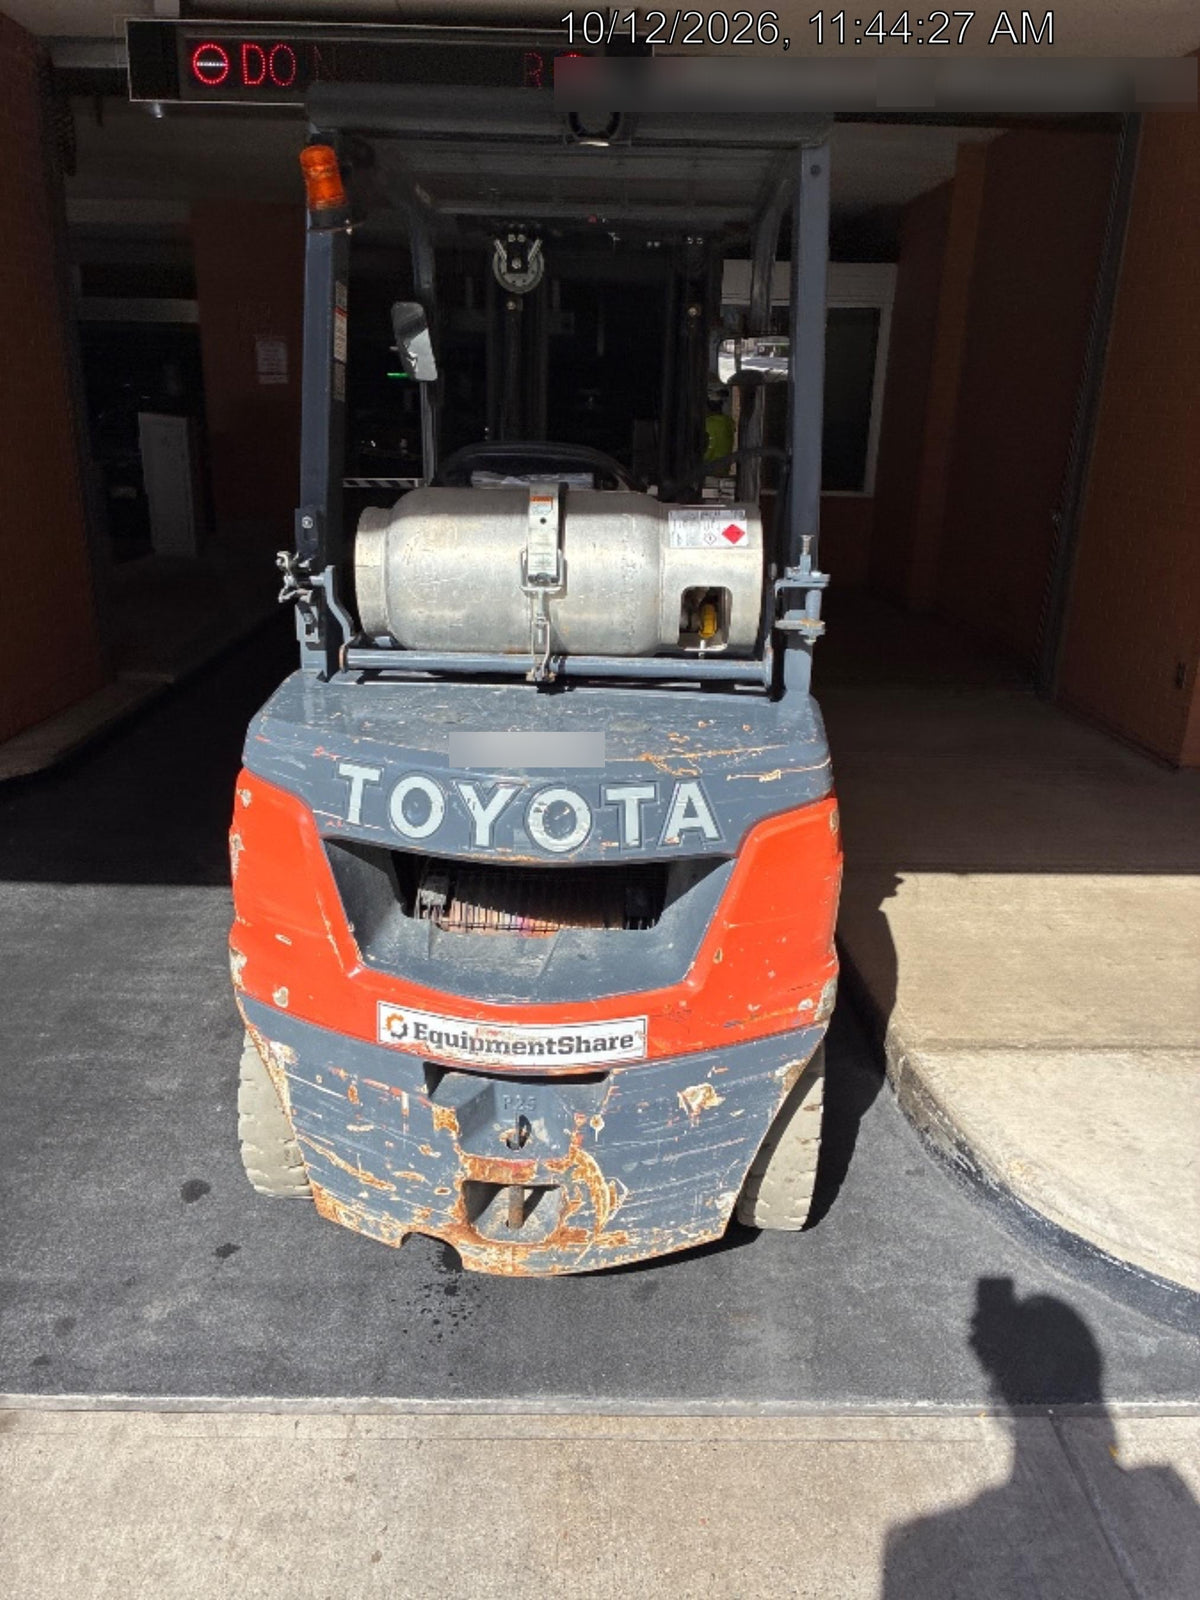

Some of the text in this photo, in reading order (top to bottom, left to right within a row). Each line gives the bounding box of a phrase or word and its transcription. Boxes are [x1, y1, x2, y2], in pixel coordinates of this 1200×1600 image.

[240, 42, 297, 87] DO
[337, 762, 721, 852] TOYOTA
[413, 1021, 634, 1056] EquipmentShare
